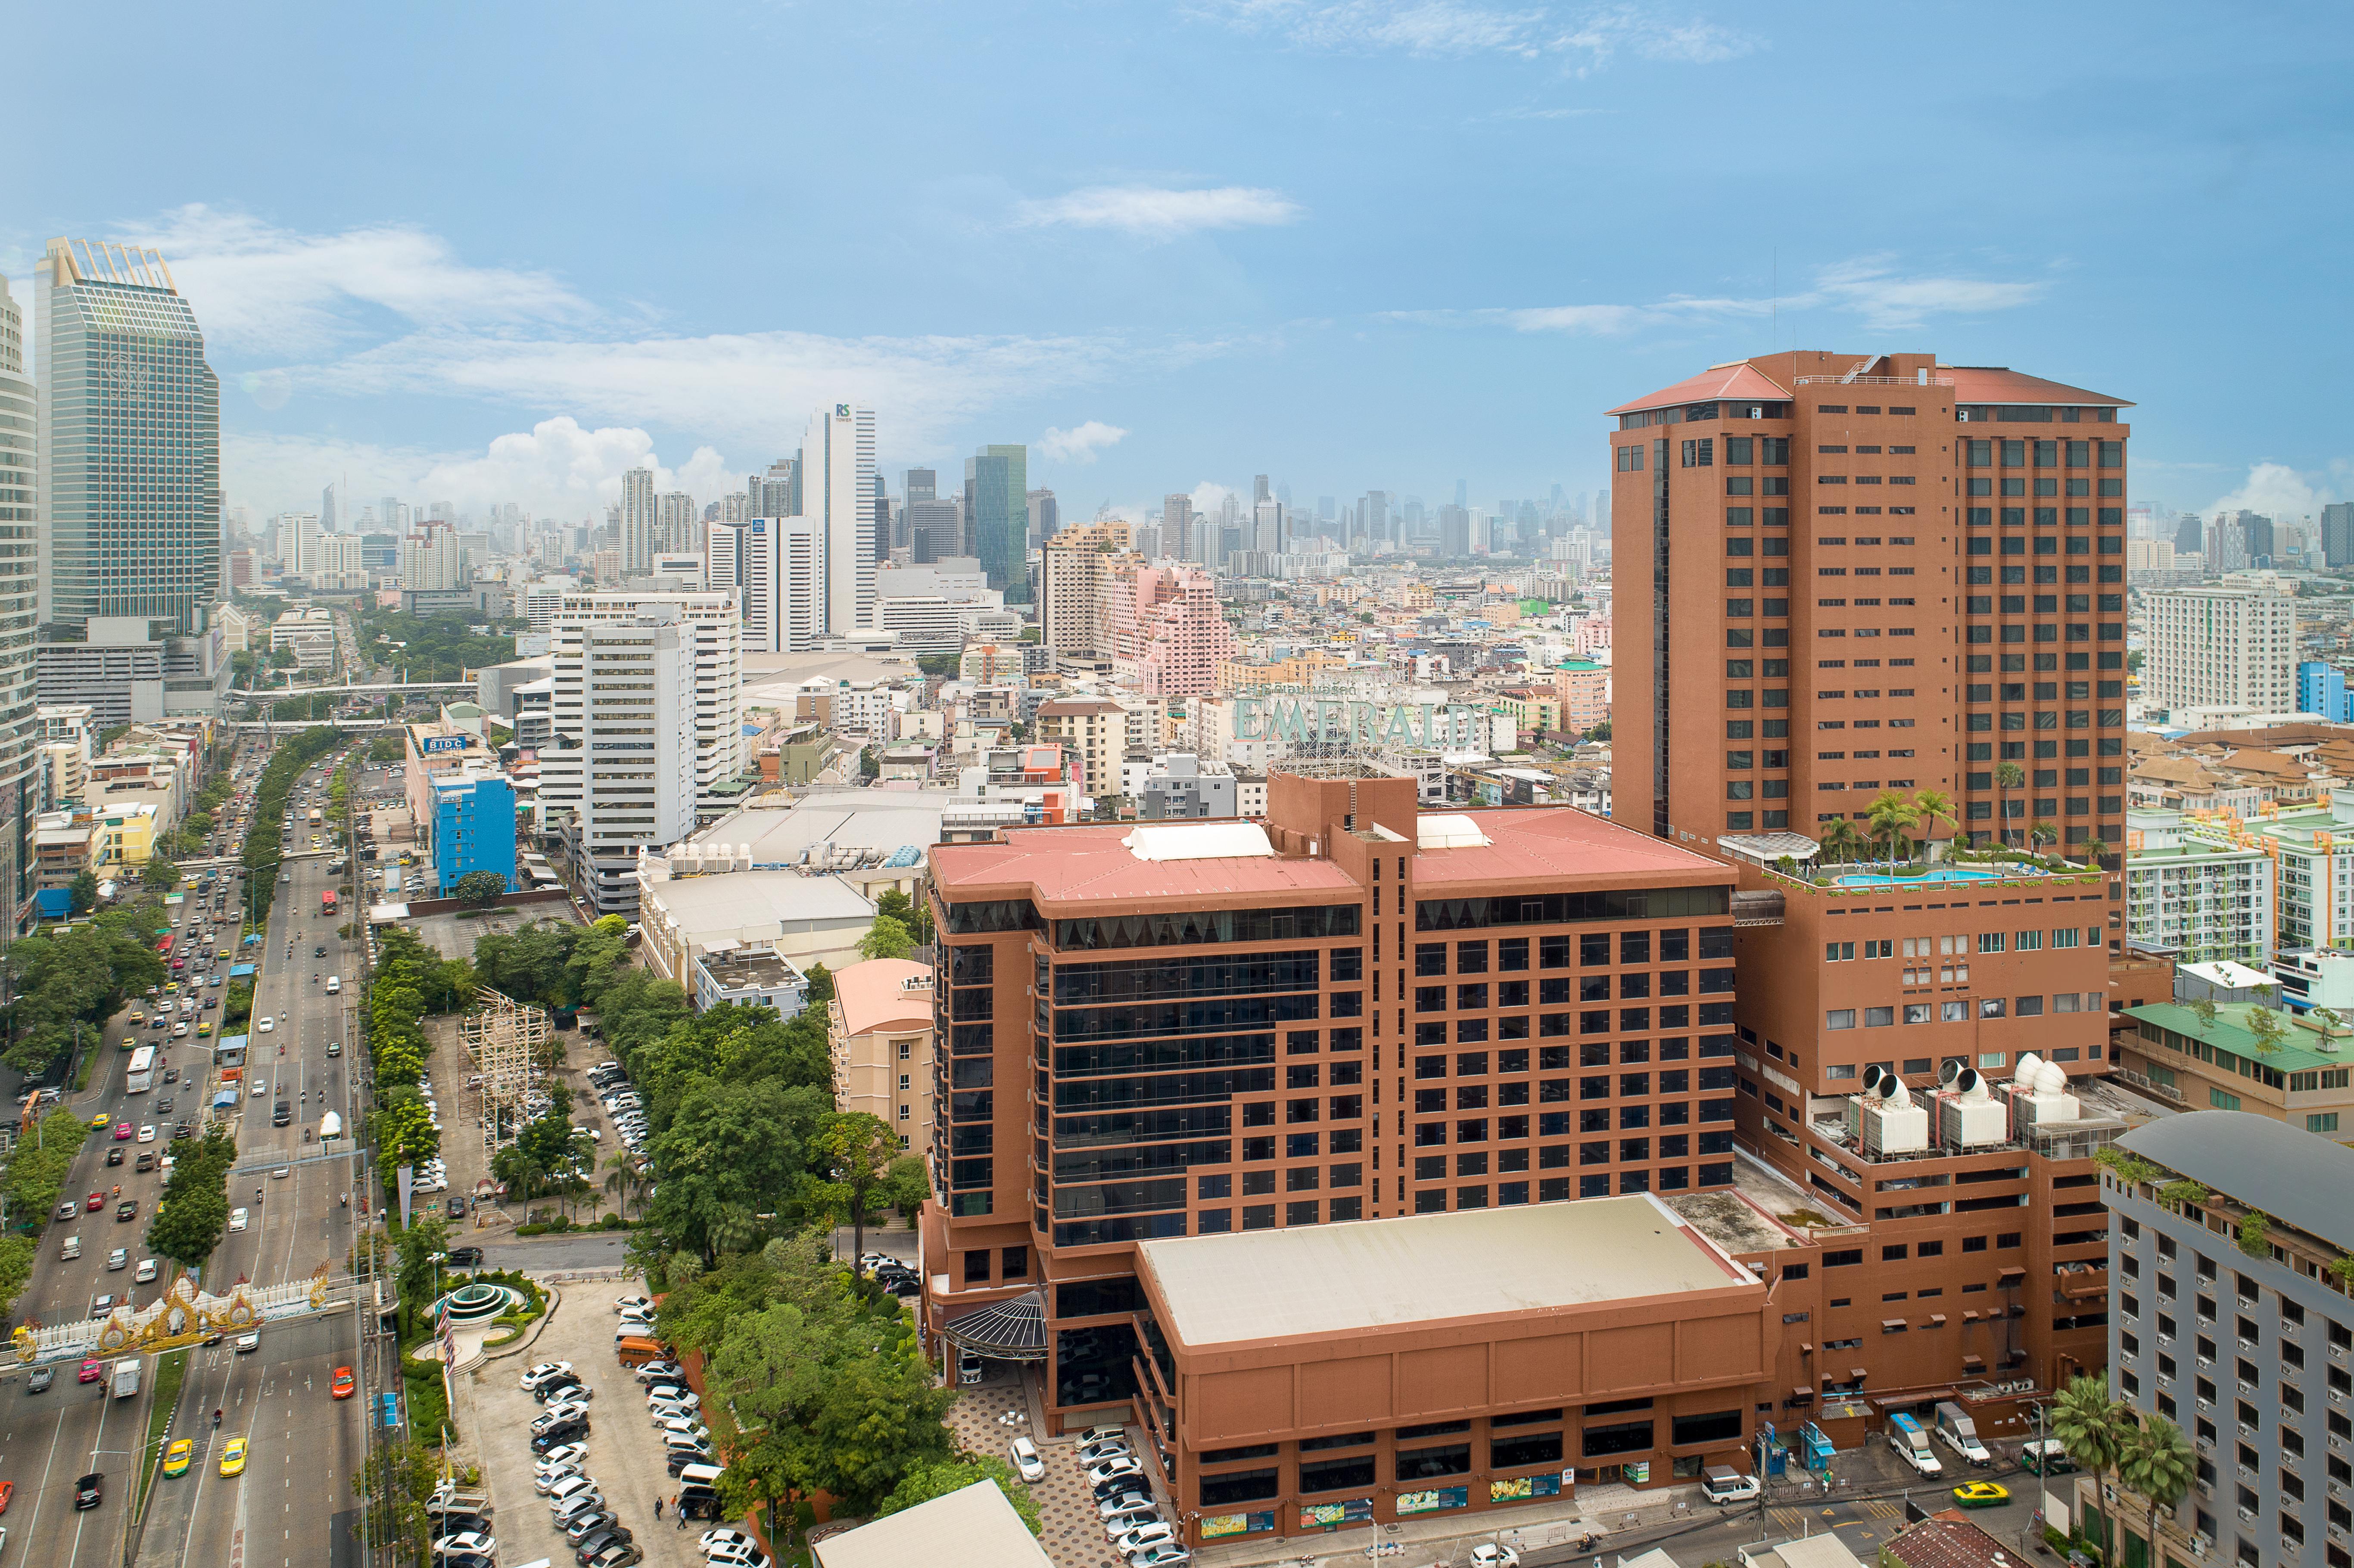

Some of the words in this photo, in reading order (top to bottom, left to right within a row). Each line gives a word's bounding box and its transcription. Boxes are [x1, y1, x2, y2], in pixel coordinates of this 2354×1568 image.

[836, 404, 850, 417] RS
[1233, 682, 1271, 696] THE
[1234, 698, 1476, 747] EMERALD
[430, 740, 462, 748] BIDC
